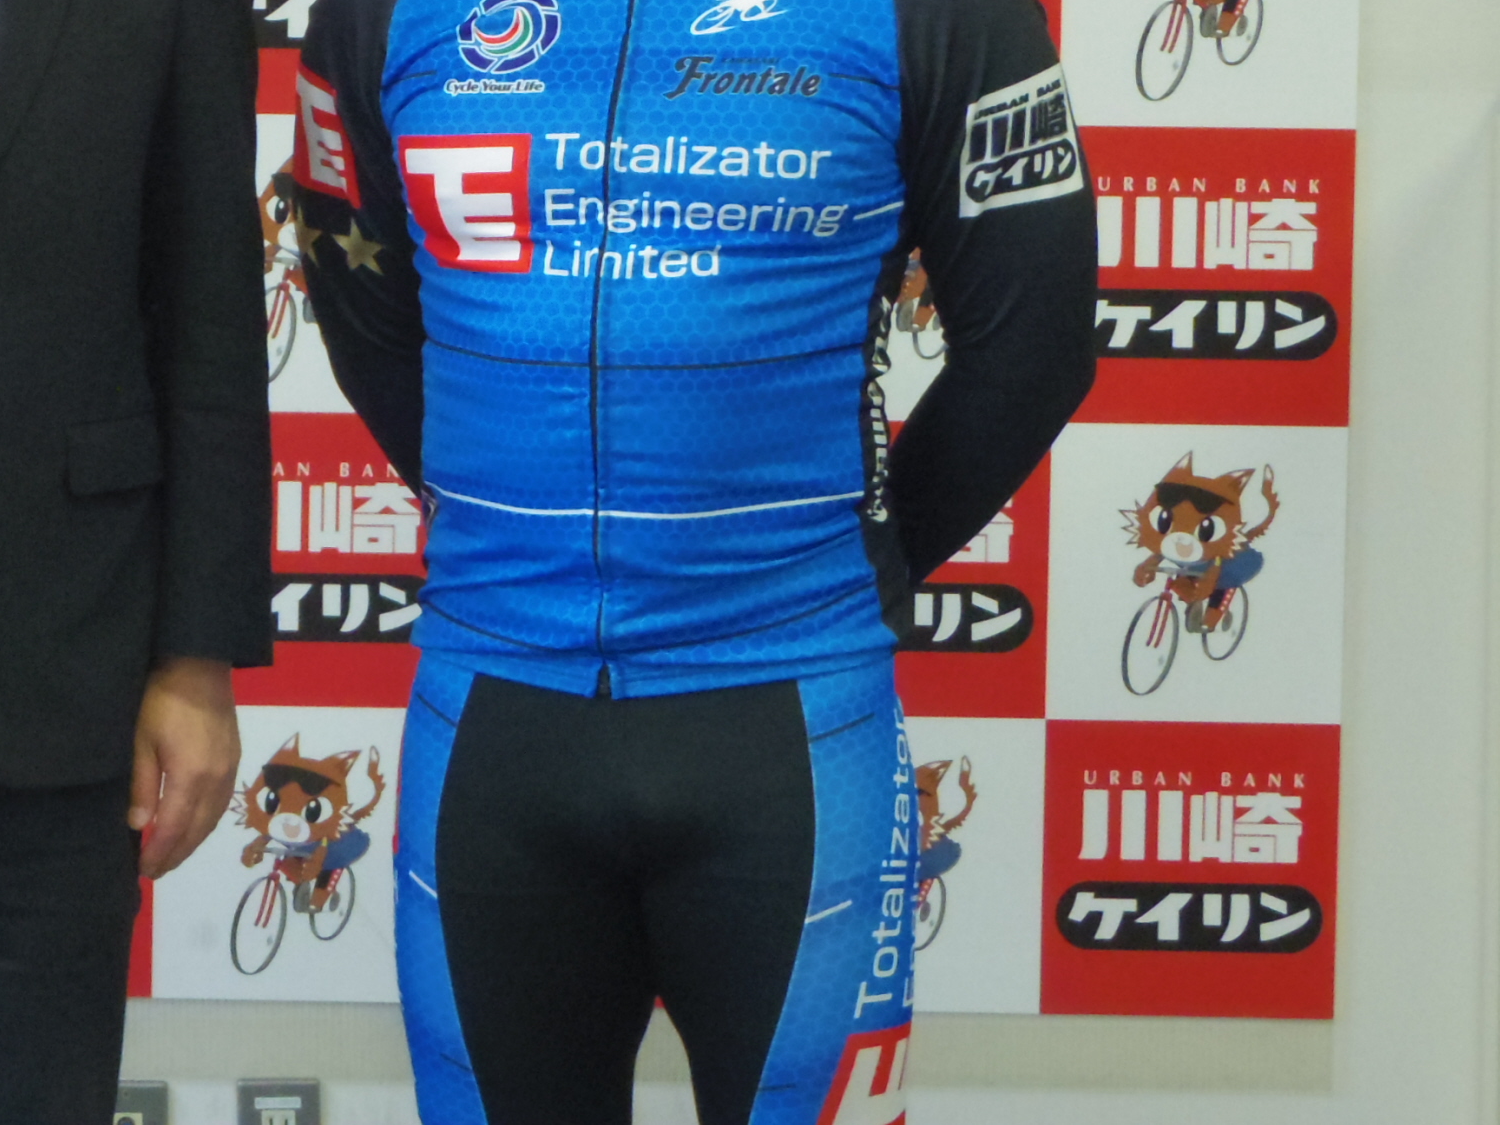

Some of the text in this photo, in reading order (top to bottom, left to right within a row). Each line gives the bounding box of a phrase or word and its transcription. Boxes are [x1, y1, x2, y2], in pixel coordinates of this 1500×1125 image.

[445, 79, 545, 96] Cycle Your Life
[664, 56, 821, 99] Frontale
[967, 93, 1068, 165] 川崎
[545, 133, 831, 179] Totalizator
[973, 147, 1072, 196] ケイリン
[1098, 177, 1318, 193] URBAN BANK
[544, 188, 848, 237] Engineering
[1097, 196, 1317, 270] 川崎
[543, 240, 721, 279] Limited
[1095, 300, 1325, 349] ケイリン
[340, 463, 399, 477] BAN
[271, 583, 422, 632] イリン
[915, 593, 1021, 641] リン
[1085, 771, 1303, 787] URBAN BANK
[1080, 790, 1302, 863] 川崎
[854, 707, 912, 1019] Totalizator
[1069, 893, 1309, 941] ケイリン
